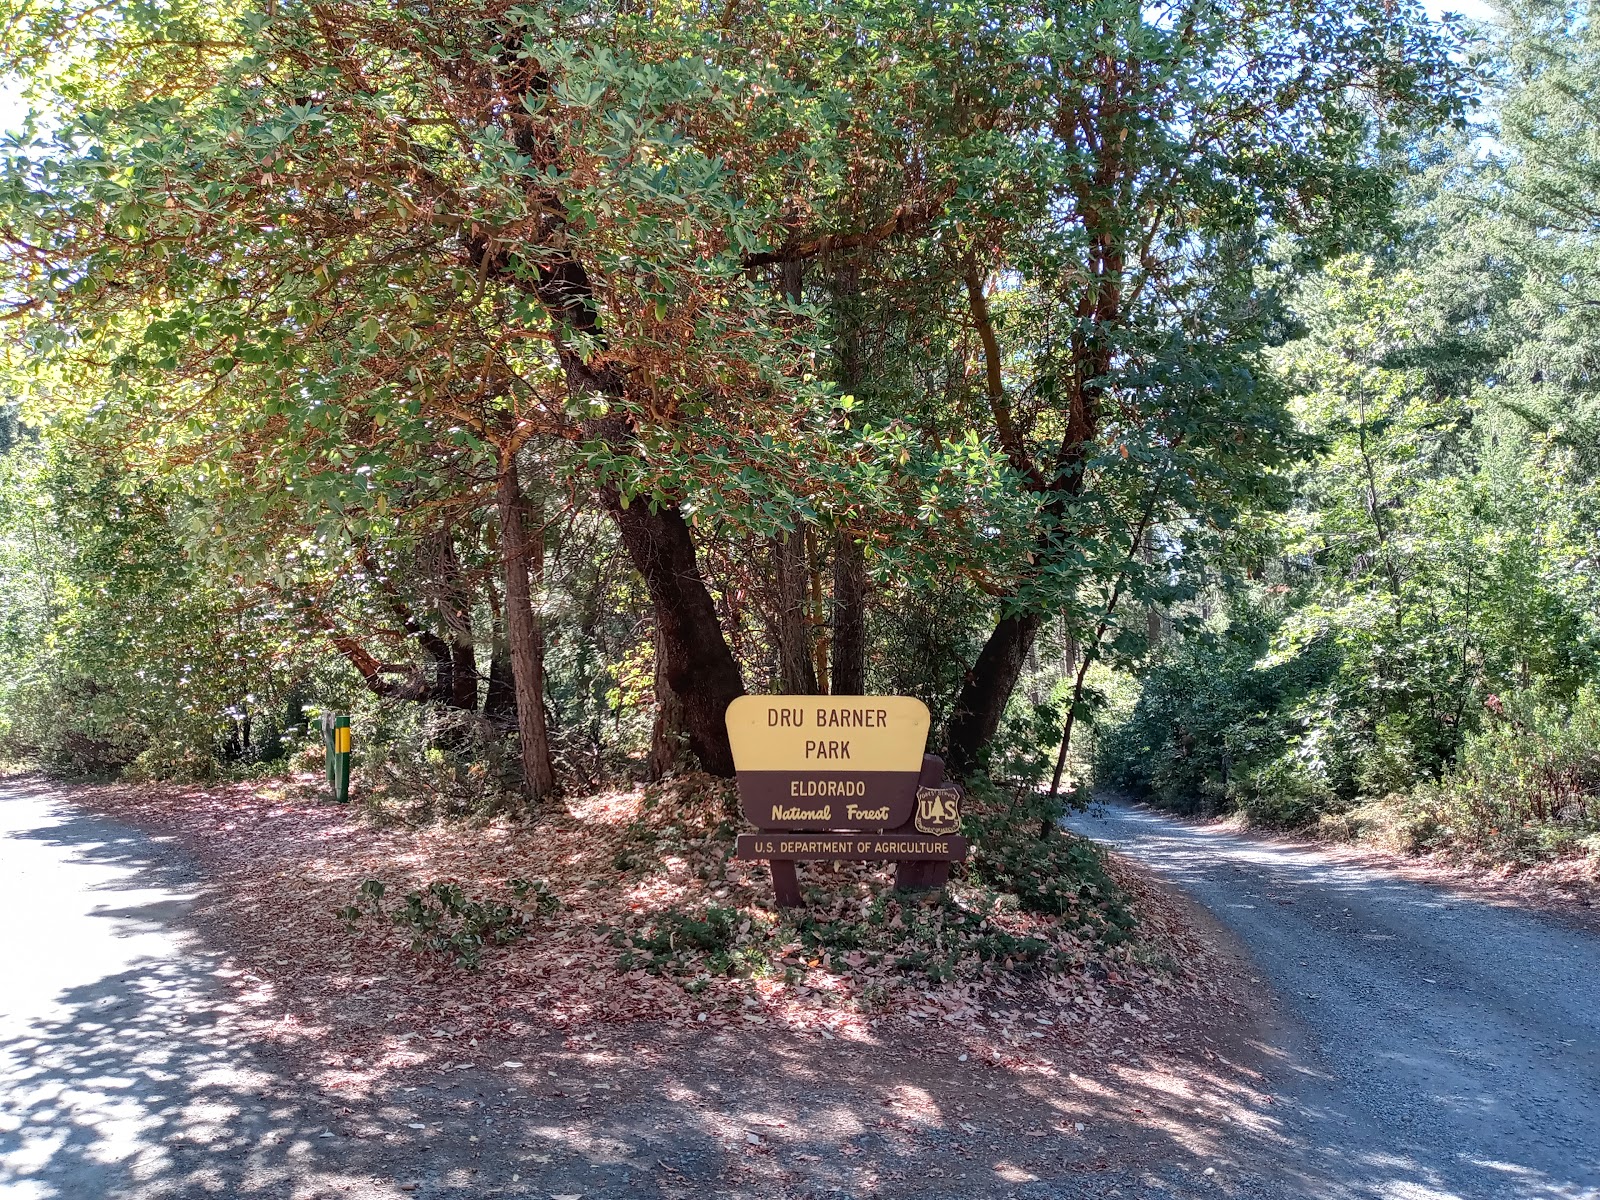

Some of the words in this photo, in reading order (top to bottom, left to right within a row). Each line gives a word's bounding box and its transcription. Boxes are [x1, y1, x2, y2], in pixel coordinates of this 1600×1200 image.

[768, 709, 803, 727] DRU
[817, 709, 887, 728] BARNER
[805, 741, 850, 759] PARK
[790, 781, 865, 797] ELDORADO
[771, 805, 831, 821] National
[846, 804, 889, 821] Forest
[755, 842, 776, 853] U.S.
[780, 842, 853, 853] DEPARTMENT
[857, 842, 871, 853] OF
[874, 842, 948, 854] AGRICULTURE
